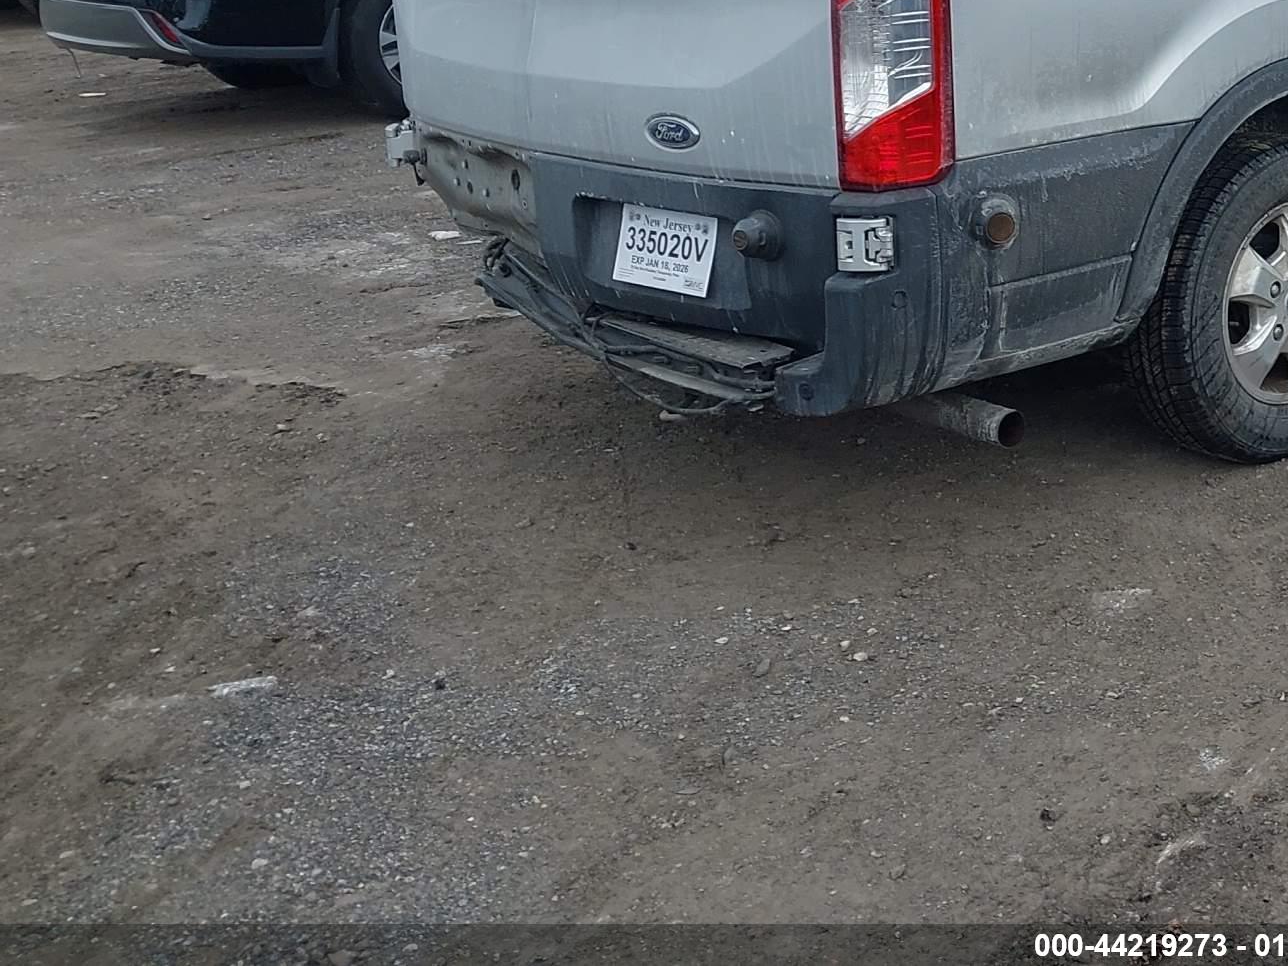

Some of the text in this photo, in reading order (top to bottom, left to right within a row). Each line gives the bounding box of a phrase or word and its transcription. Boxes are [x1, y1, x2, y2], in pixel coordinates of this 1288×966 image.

[655, 122, 684, 141] Ford
[643, 214, 694, 235] New Jersey
[625, 226, 709, 262] 335020V
[631, 254, 644, 265] EXP
[645, 258, 660, 269] JAN
